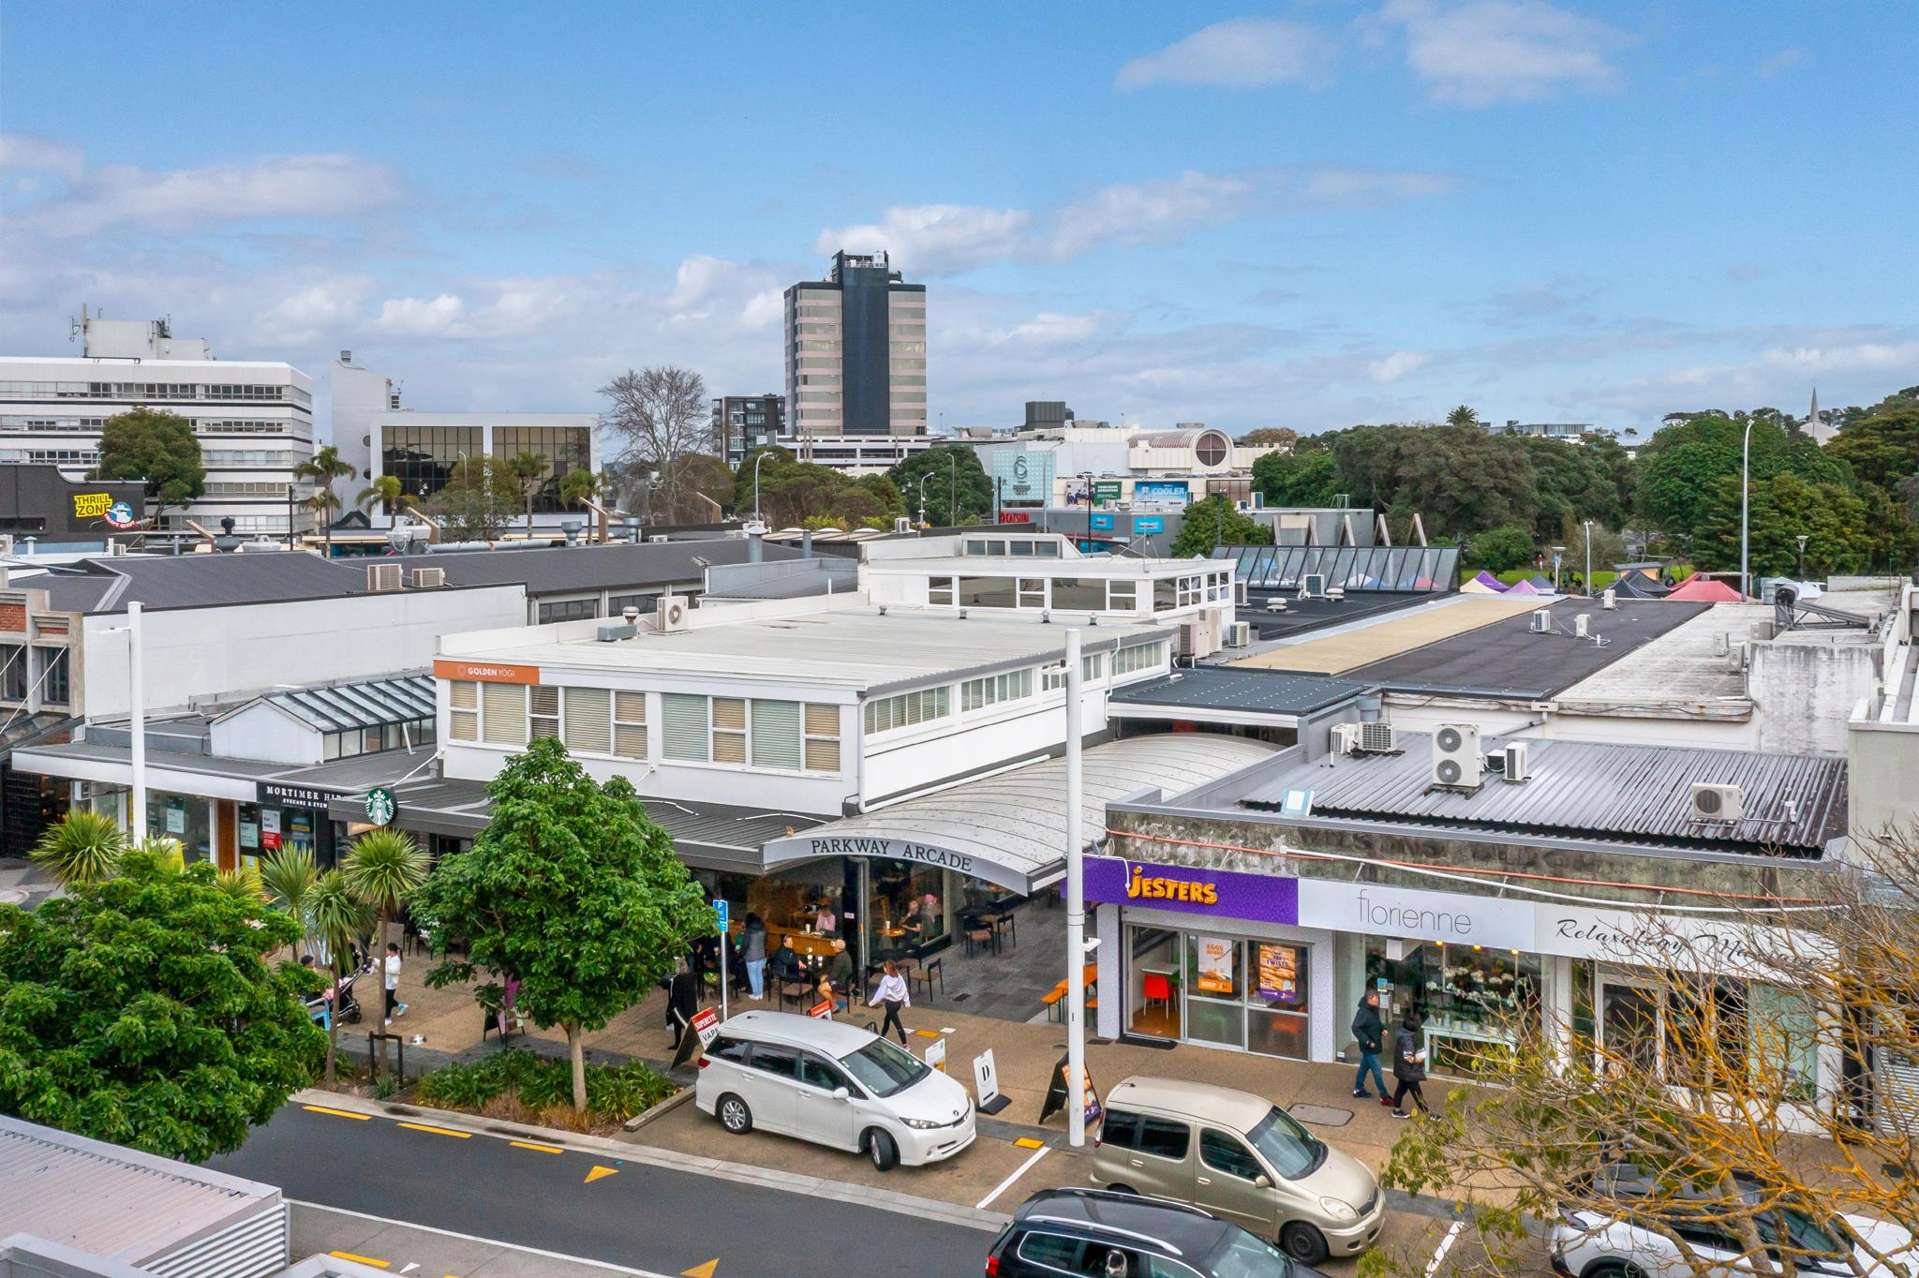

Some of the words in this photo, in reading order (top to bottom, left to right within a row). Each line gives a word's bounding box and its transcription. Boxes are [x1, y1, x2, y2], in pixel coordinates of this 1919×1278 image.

[76, 496, 111, 506] THRILL
[467, 667, 497, 677] GOLDEN
[811, 839, 890, 855] PARKWAY
[902, 844, 973, 872] ARCADE
[1356, 888, 1471, 935] florienne
